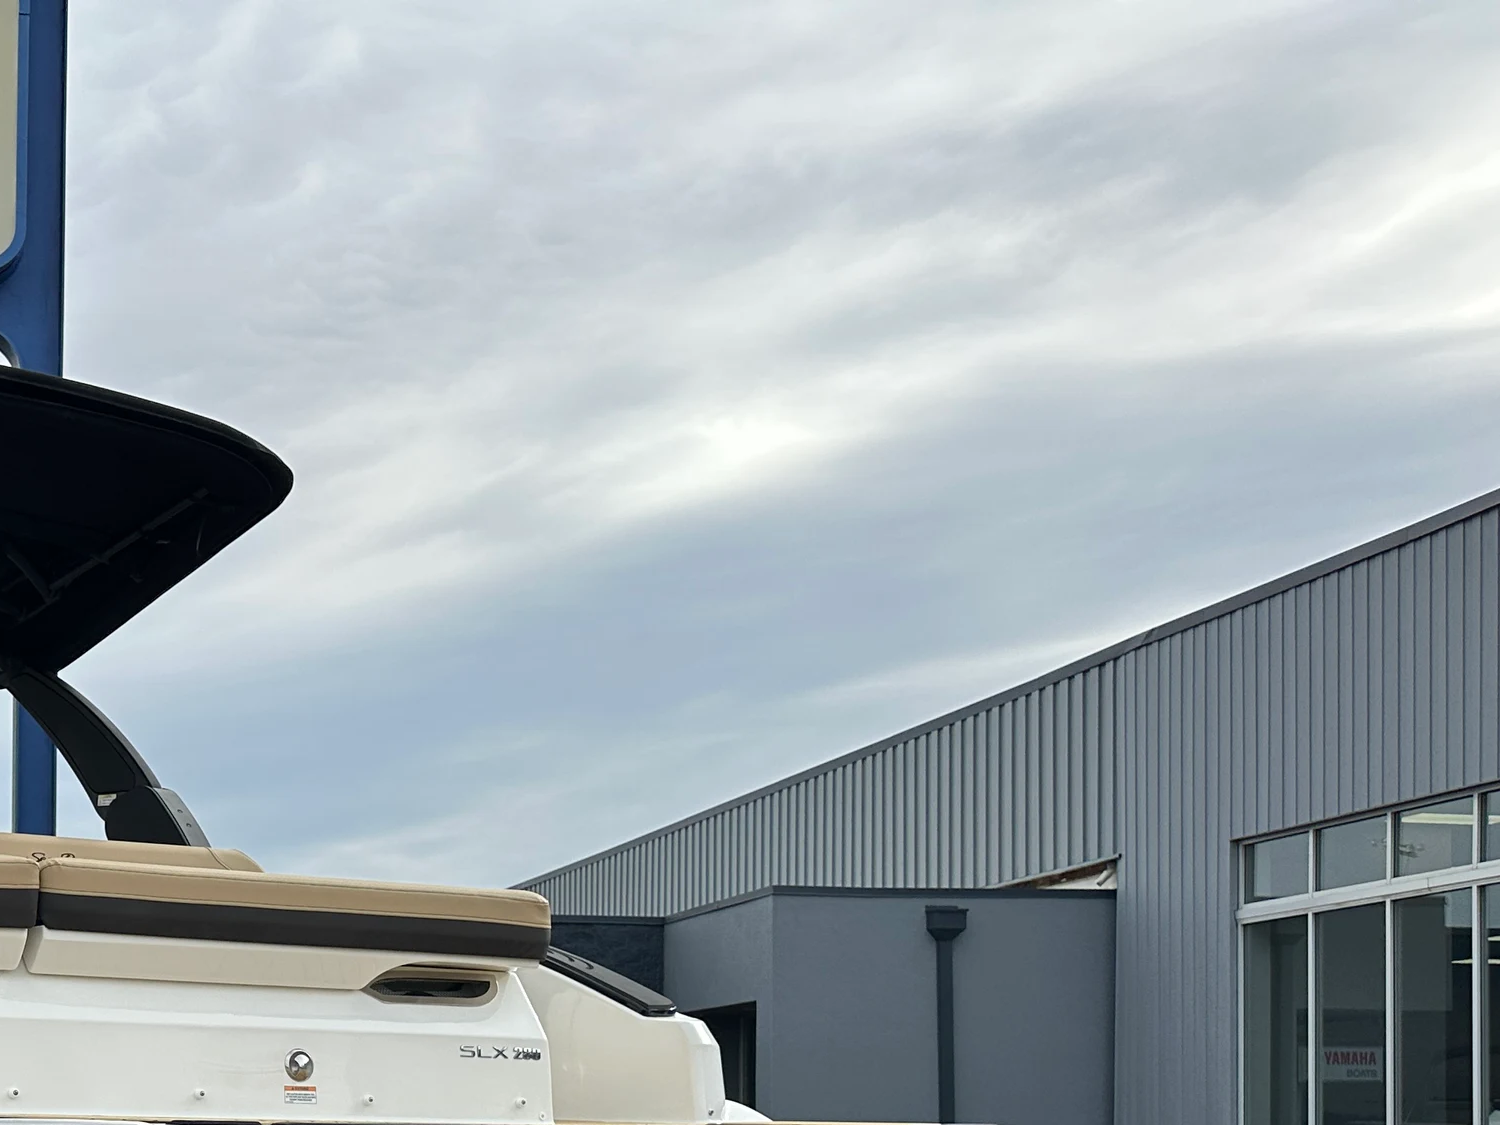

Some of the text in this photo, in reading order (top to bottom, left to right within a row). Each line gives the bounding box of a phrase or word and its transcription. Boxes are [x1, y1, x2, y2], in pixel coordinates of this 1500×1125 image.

[459, 1044, 509, 1060] SLX
[1324, 1051, 1377, 1066] YAMAHA
[1346, 1068, 1378, 1079] BOATS
